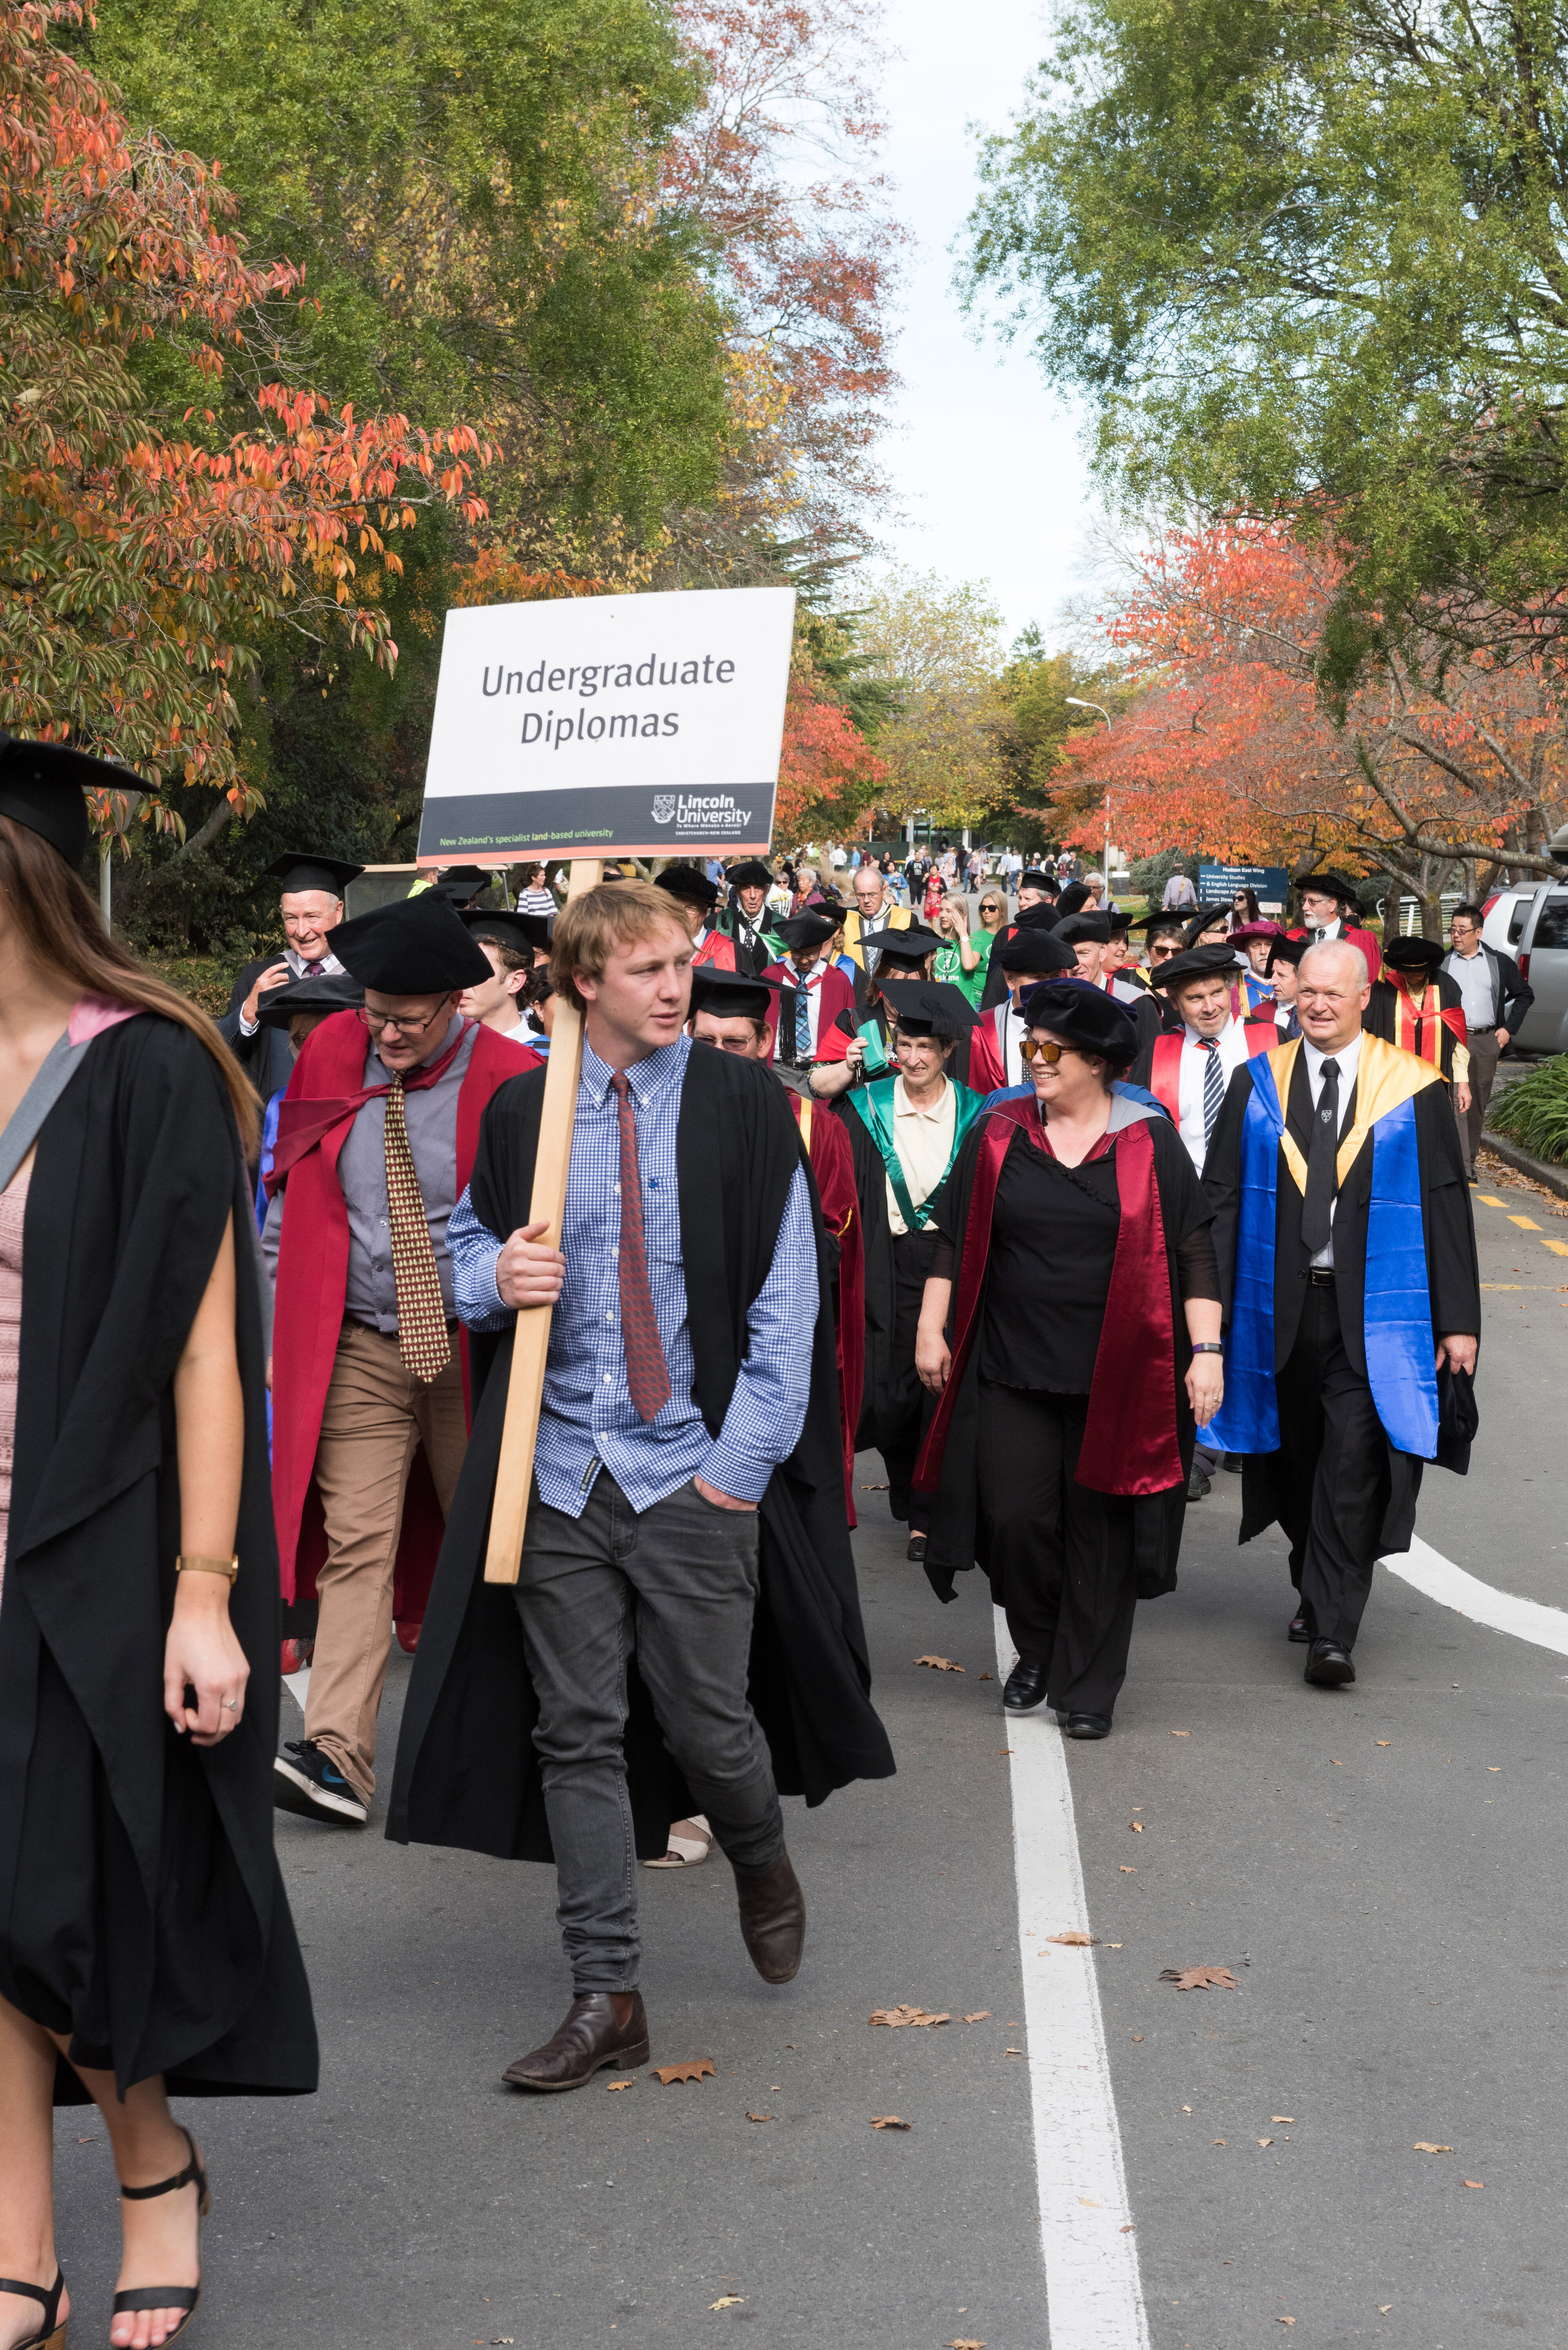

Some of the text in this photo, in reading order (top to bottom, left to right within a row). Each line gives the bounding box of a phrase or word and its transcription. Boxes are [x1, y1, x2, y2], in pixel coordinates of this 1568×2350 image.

[483, 653, 735, 697] Undergraduate
[521, 707, 679, 750] Diplomas
[678, 794, 734, 809] Lincoln
[677, 808, 751, 826] University
[495, 834, 530, 844] specialist
[532, 830, 573, 841] land-based
[574, 829, 613, 838] university
